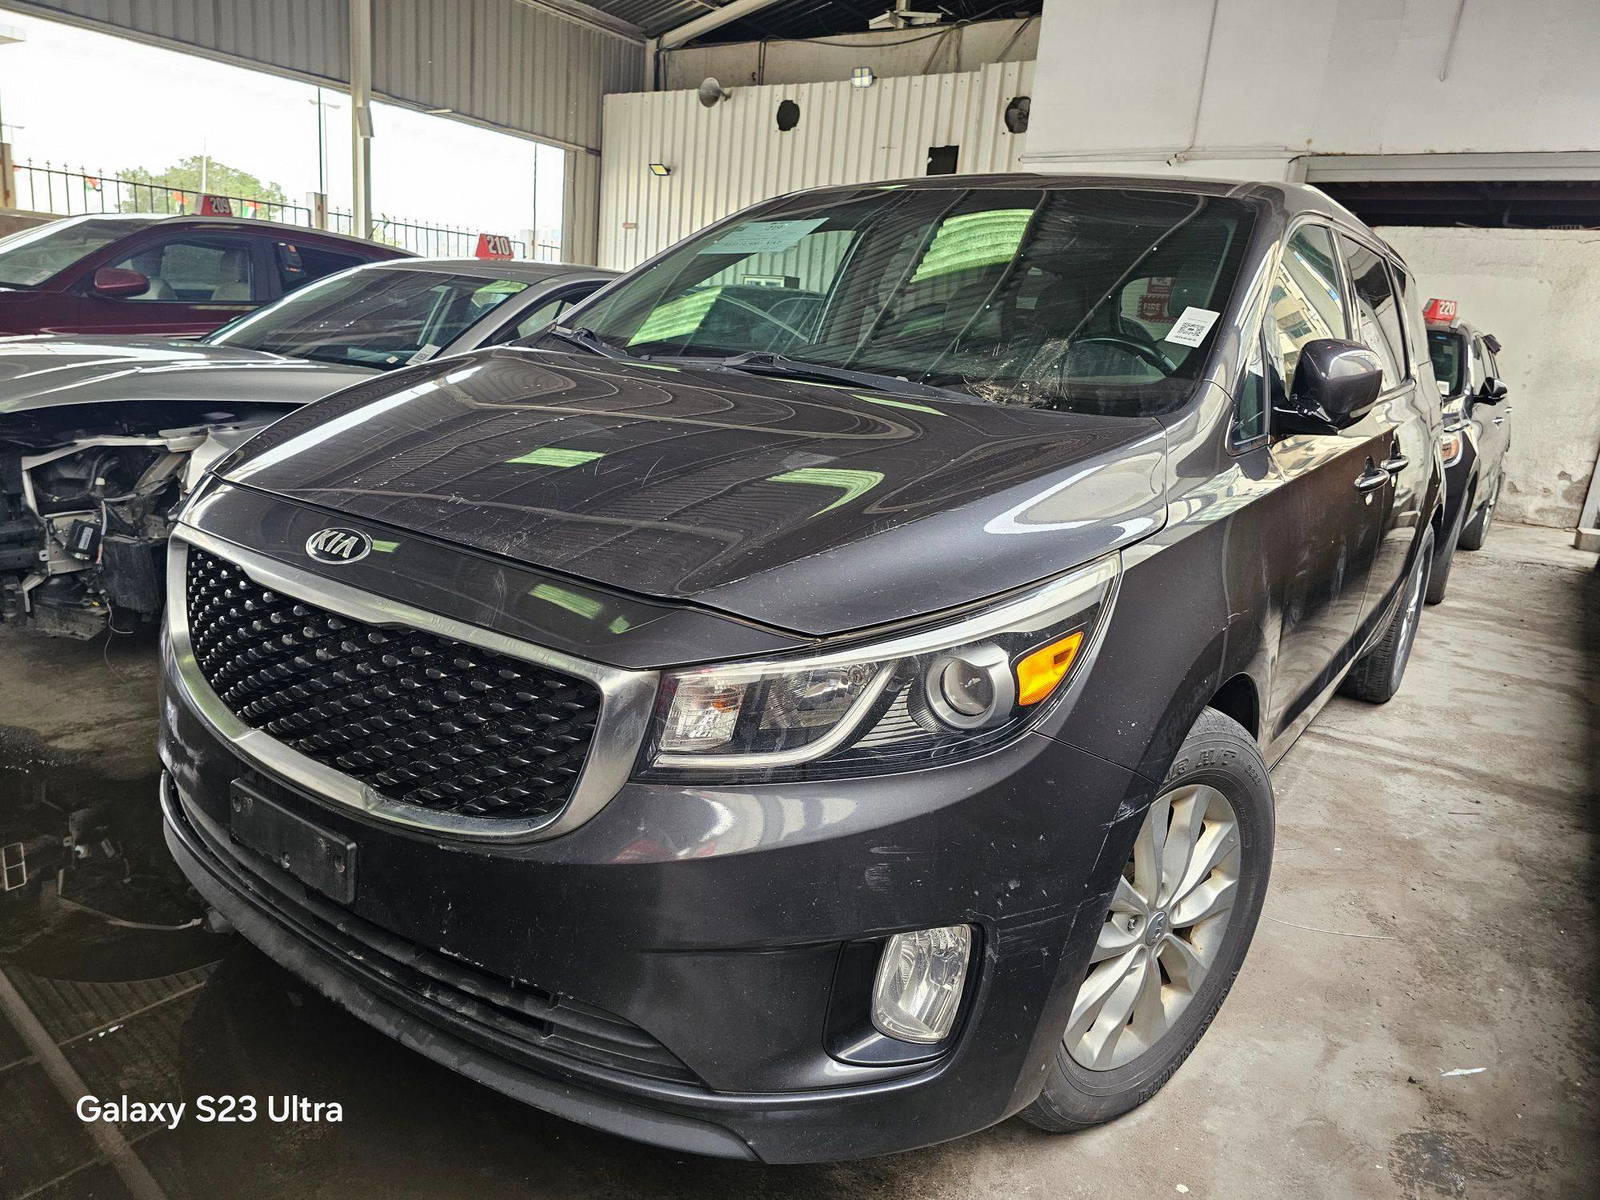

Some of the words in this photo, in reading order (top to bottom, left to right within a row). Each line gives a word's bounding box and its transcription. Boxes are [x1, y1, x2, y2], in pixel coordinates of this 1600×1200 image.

[209, 197, 230, 214] 209
[486, 235, 510, 256] 210
[1439, 301, 1455, 315] 220
[312, 529, 359, 559] KIA
